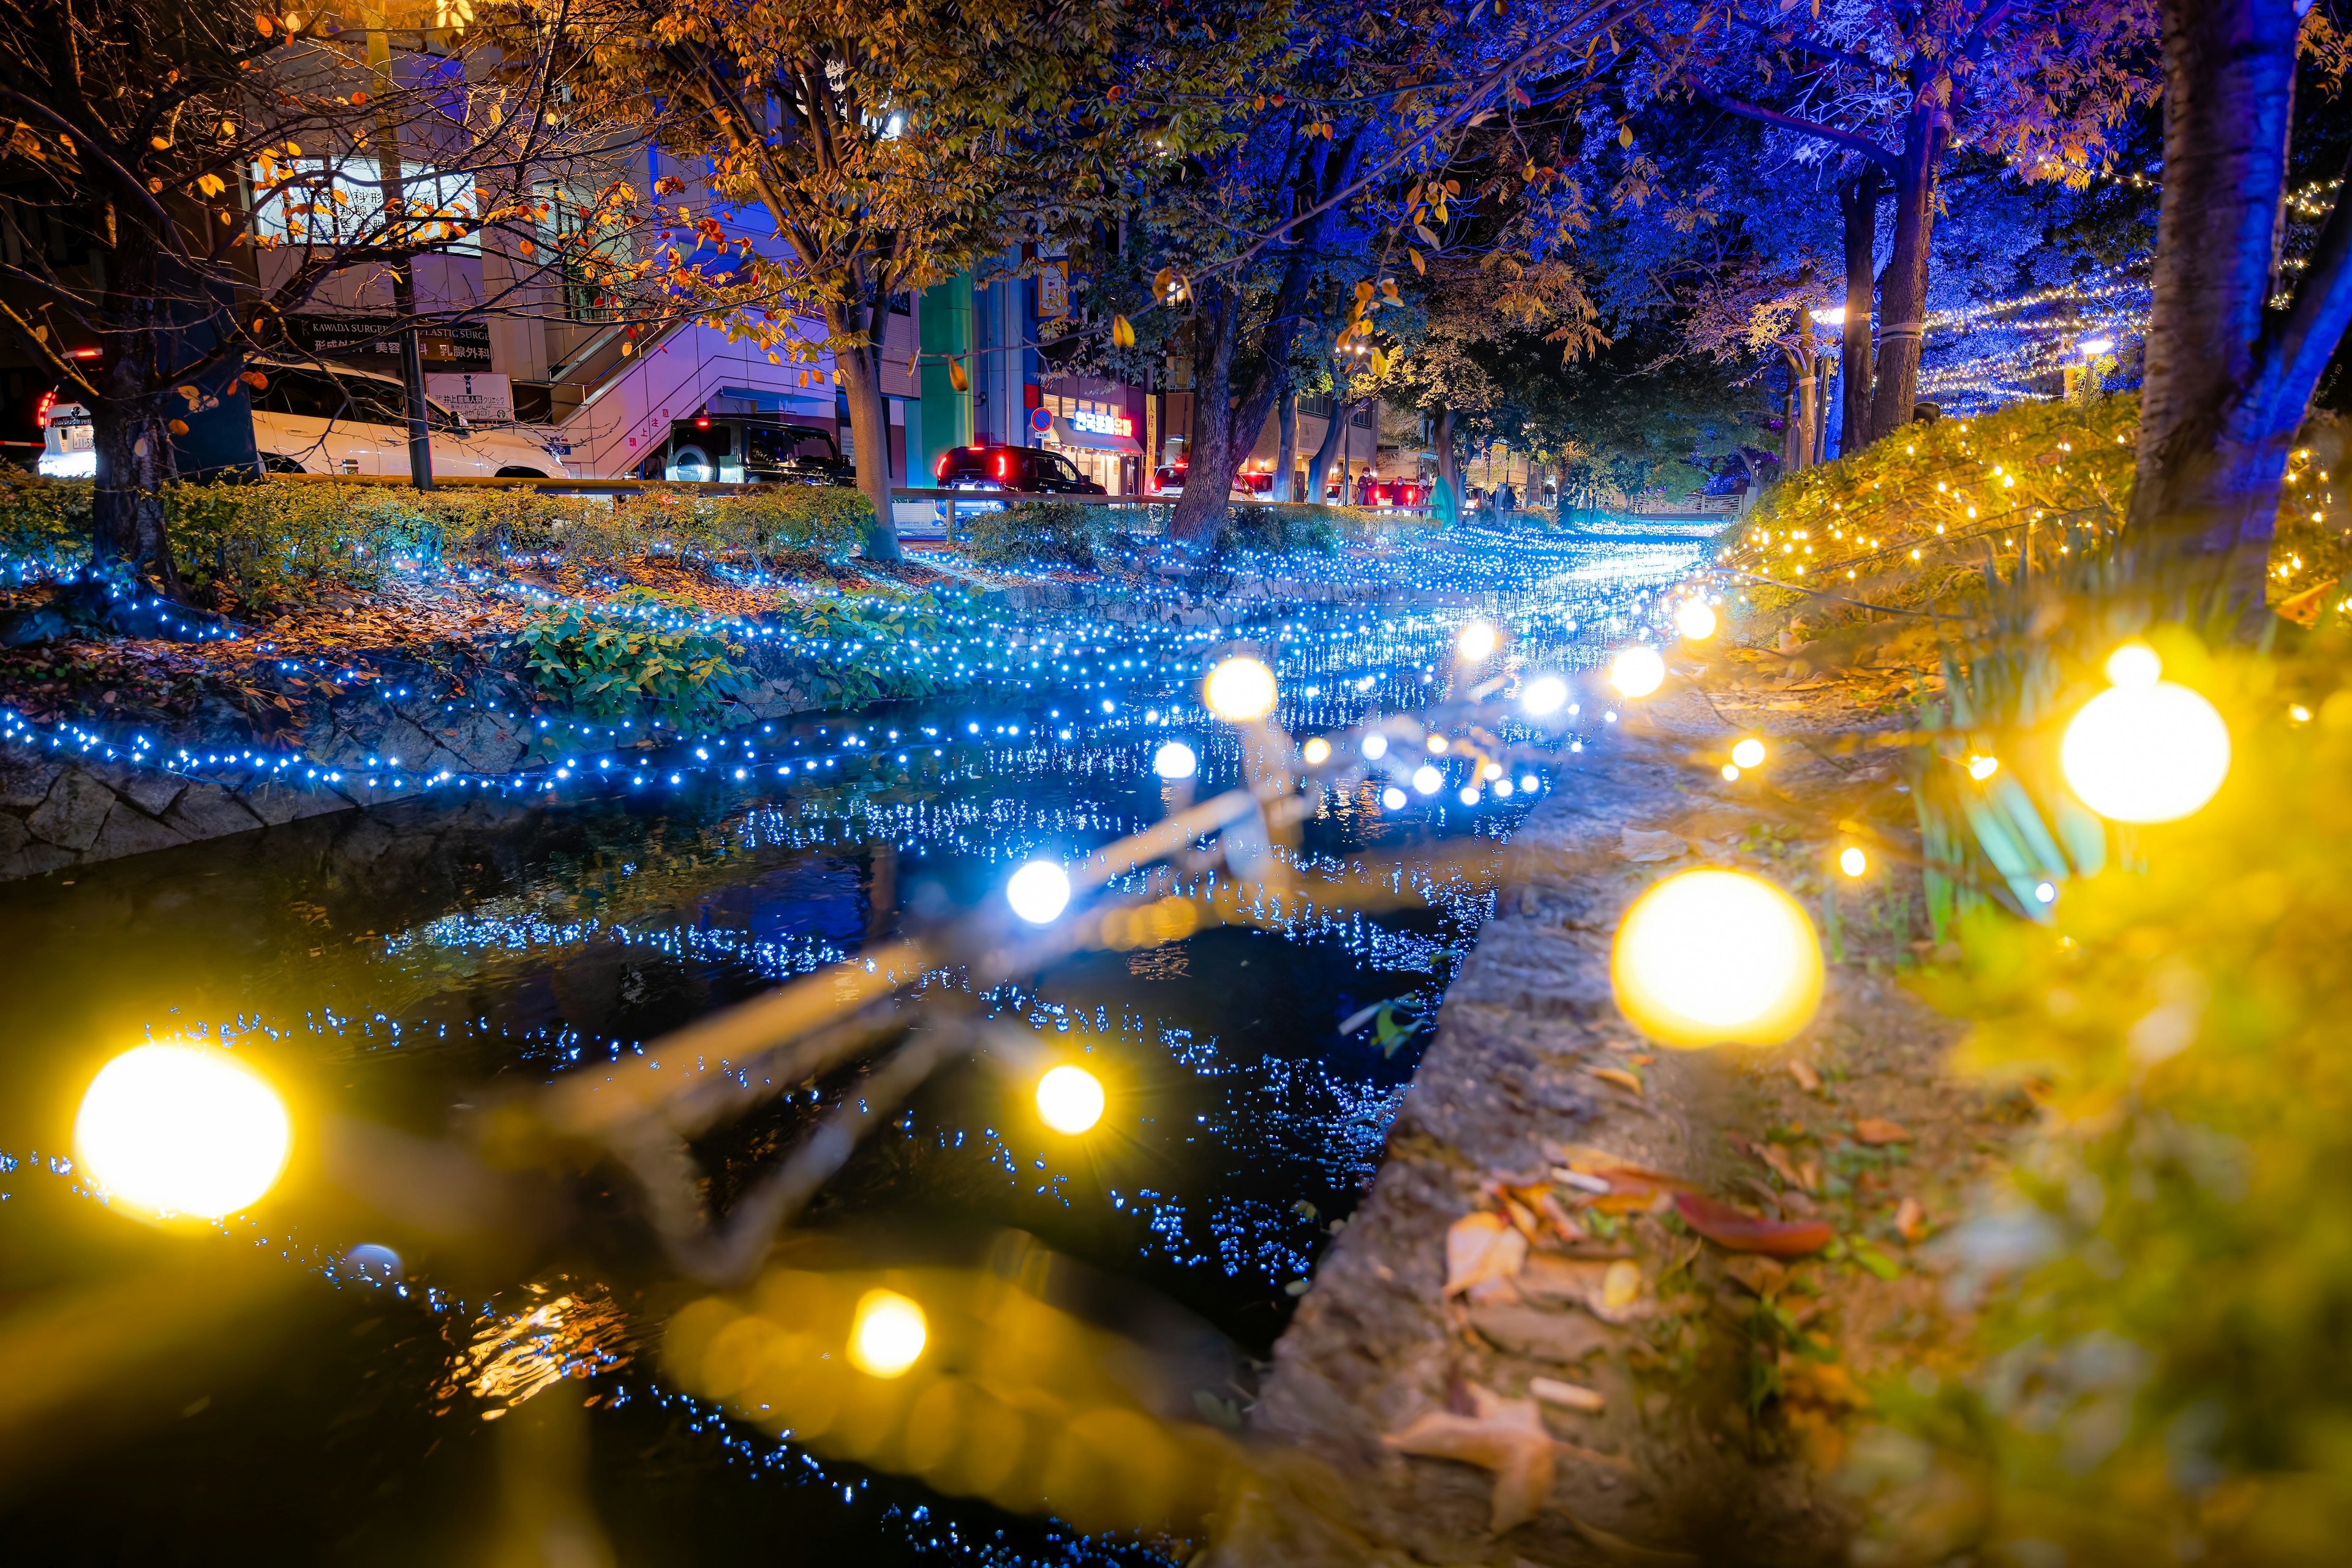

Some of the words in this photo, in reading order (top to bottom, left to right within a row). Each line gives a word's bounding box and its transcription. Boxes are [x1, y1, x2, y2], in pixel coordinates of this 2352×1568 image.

[313, 323, 350, 332] KAWADA
[439, 344, 490, 360] 乳腺外科
[629, 409, 669, 447] 頭上注意
